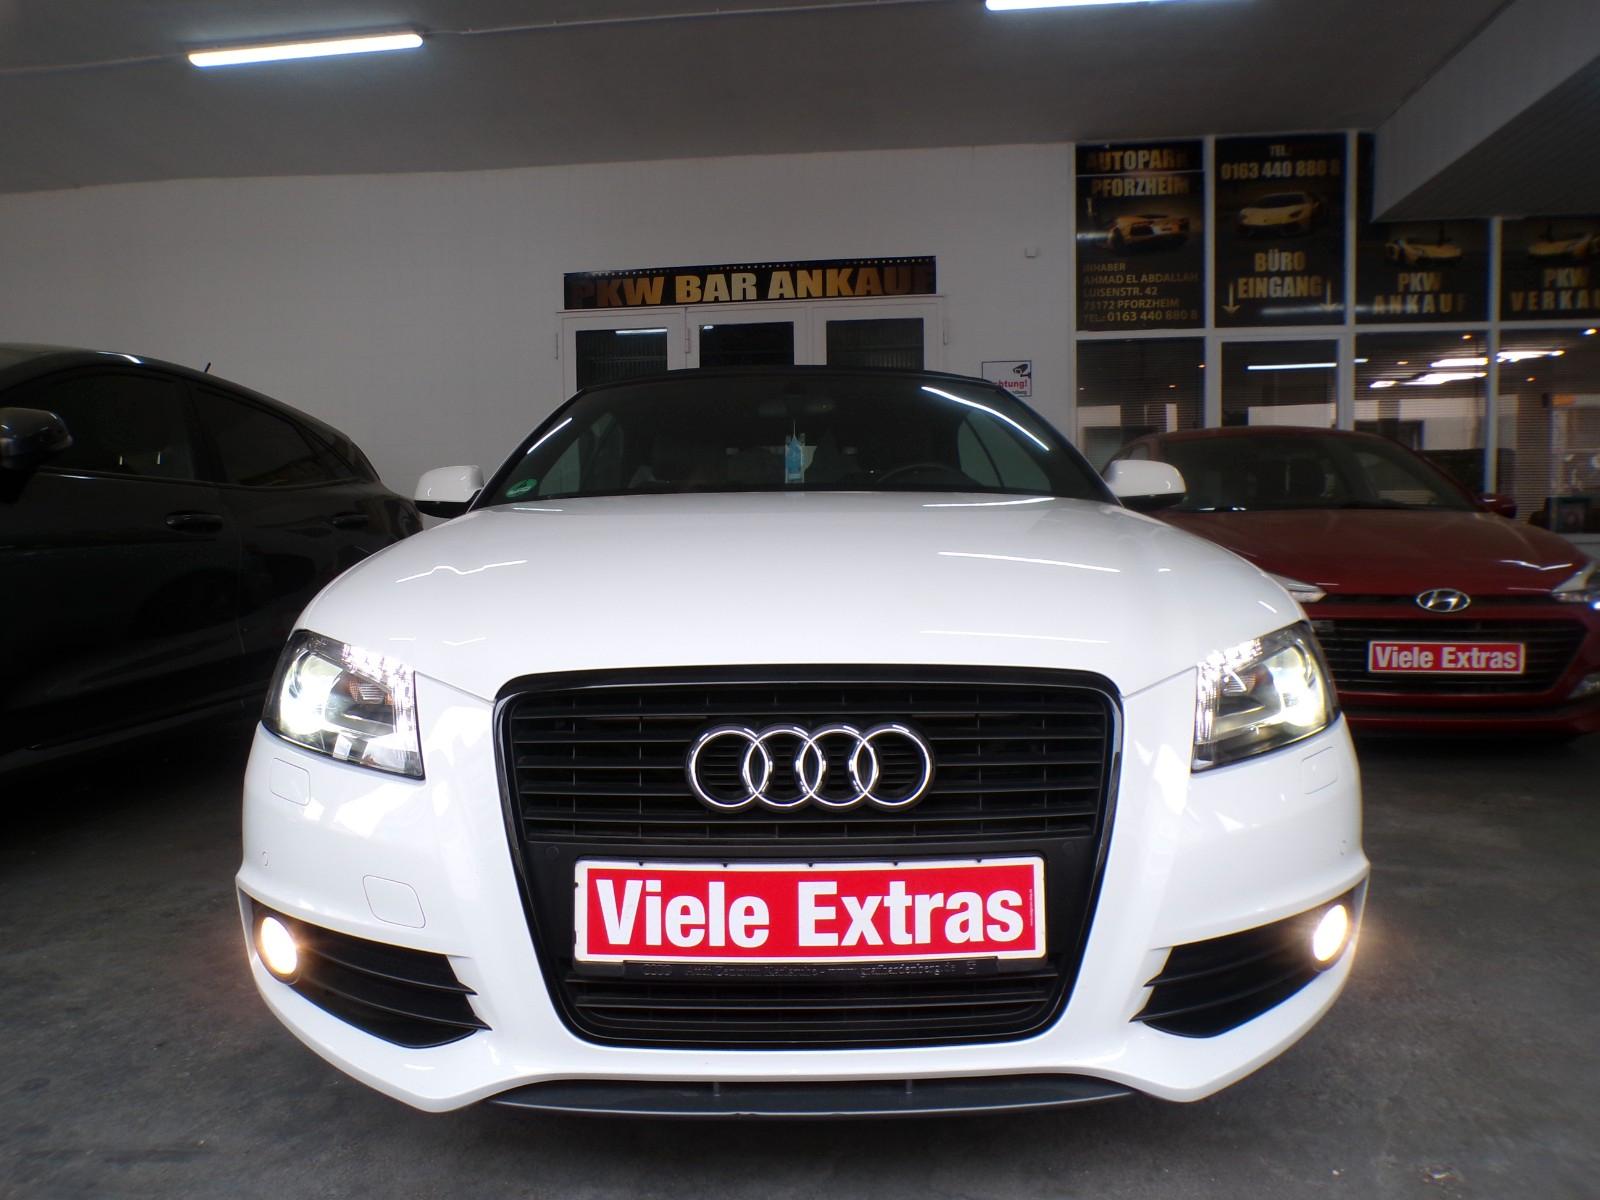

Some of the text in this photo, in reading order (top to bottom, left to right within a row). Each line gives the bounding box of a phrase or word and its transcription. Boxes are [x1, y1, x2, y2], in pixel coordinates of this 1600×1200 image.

[1221, 161, 1260, 180] 0163
[1261, 160, 1294, 178] 440
[1091, 176, 1190, 197] PFORZHEIM
[1254, 249, 1306, 273] BÜRO
[675, 271, 758, 304] BAR
[1084, 274, 1124, 285] AHMAD
[1125, 274, 1139, 284] EL
[1237, 275, 1324, 299] EINGANG
[1397, 272, 1441, 292] PKW
[1144, 286, 1159, 296] 42
[1107, 311, 1138, 322] 0163
[1139, 311, 1163, 321] 440
[1375, 646, 1517, 669] Viele Extras
[596, 879, 770, 948] Viele
[798, 880, 1024, 947] Extras
